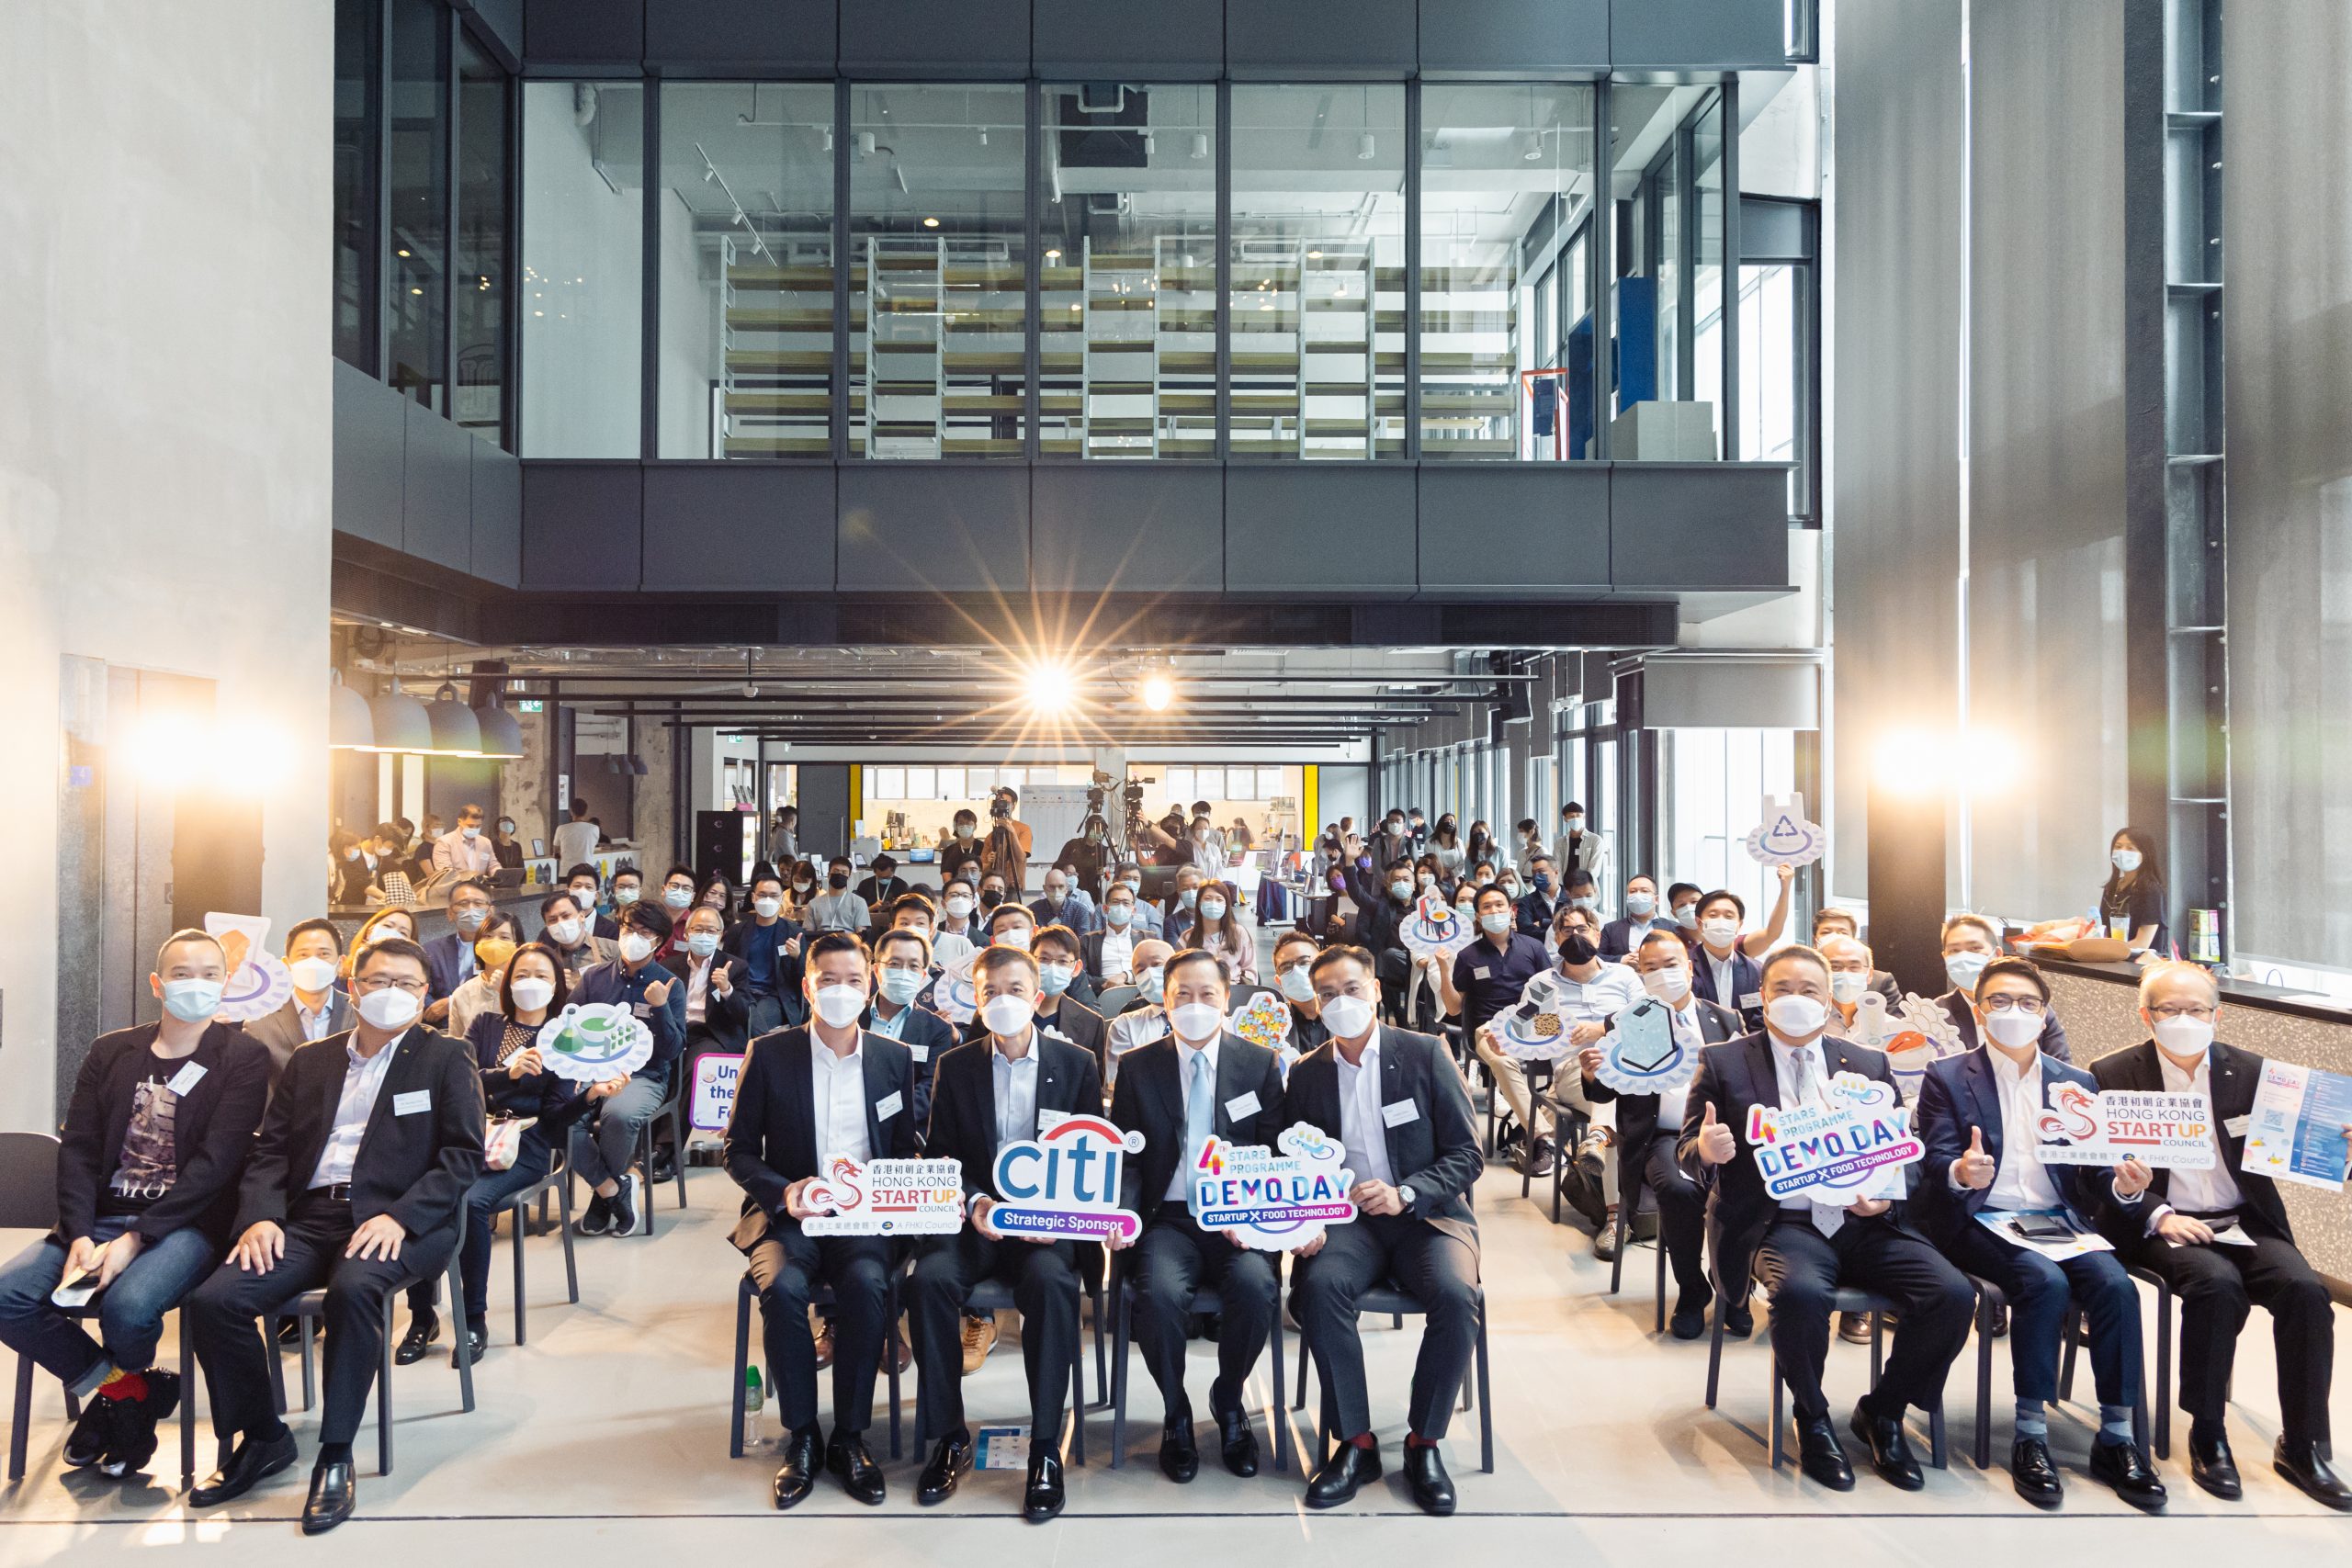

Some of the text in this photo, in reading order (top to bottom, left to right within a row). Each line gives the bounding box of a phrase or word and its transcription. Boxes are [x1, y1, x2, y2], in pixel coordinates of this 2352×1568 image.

[710, 1086, 735, 1099] the
[2106, 1096, 2203, 1109] 香港初創企業協會
[1779, 1108, 1816, 1126] STARS
[2107, 1108, 2205, 1122] HONG KONG
[1782, 1110, 1856, 1139] PROGRAMME
[1758, 1111, 1907, 1177] DEMO DAY
[2163, 1139, 2207, 1148] COUNCIL
[1228, 1150, 1266, 1162] STARS
[2172, 1155, 2210, 1165] Council
[873, 1164, 956, 1175] 香港初創企業協會
[999, 1135, 1116, 1202] citi
[1229, 1161, 1301, 1175] PROGRAMME
[1777, 1173, 1817, 1191] STARTUP
[1830, 1162, 1855, 1177] FOOD
[1855, 1145, 1913, 1168] TECHNOLOGY
[873, 1176, 956, 1187] HONG KONG
[1201, 1175, 1349, 1206] DEMO DAY
[1207, 1213, 1249, 1223] STARTUP
[1262, 1210, 1286, 1220] FOOD
[1287, 1207, 1346, 1218] TECHNOLOGY
[924, 1221, 957, 1229] Council
[1004, 1213, 1124, 1232] Strategic Sponsor
